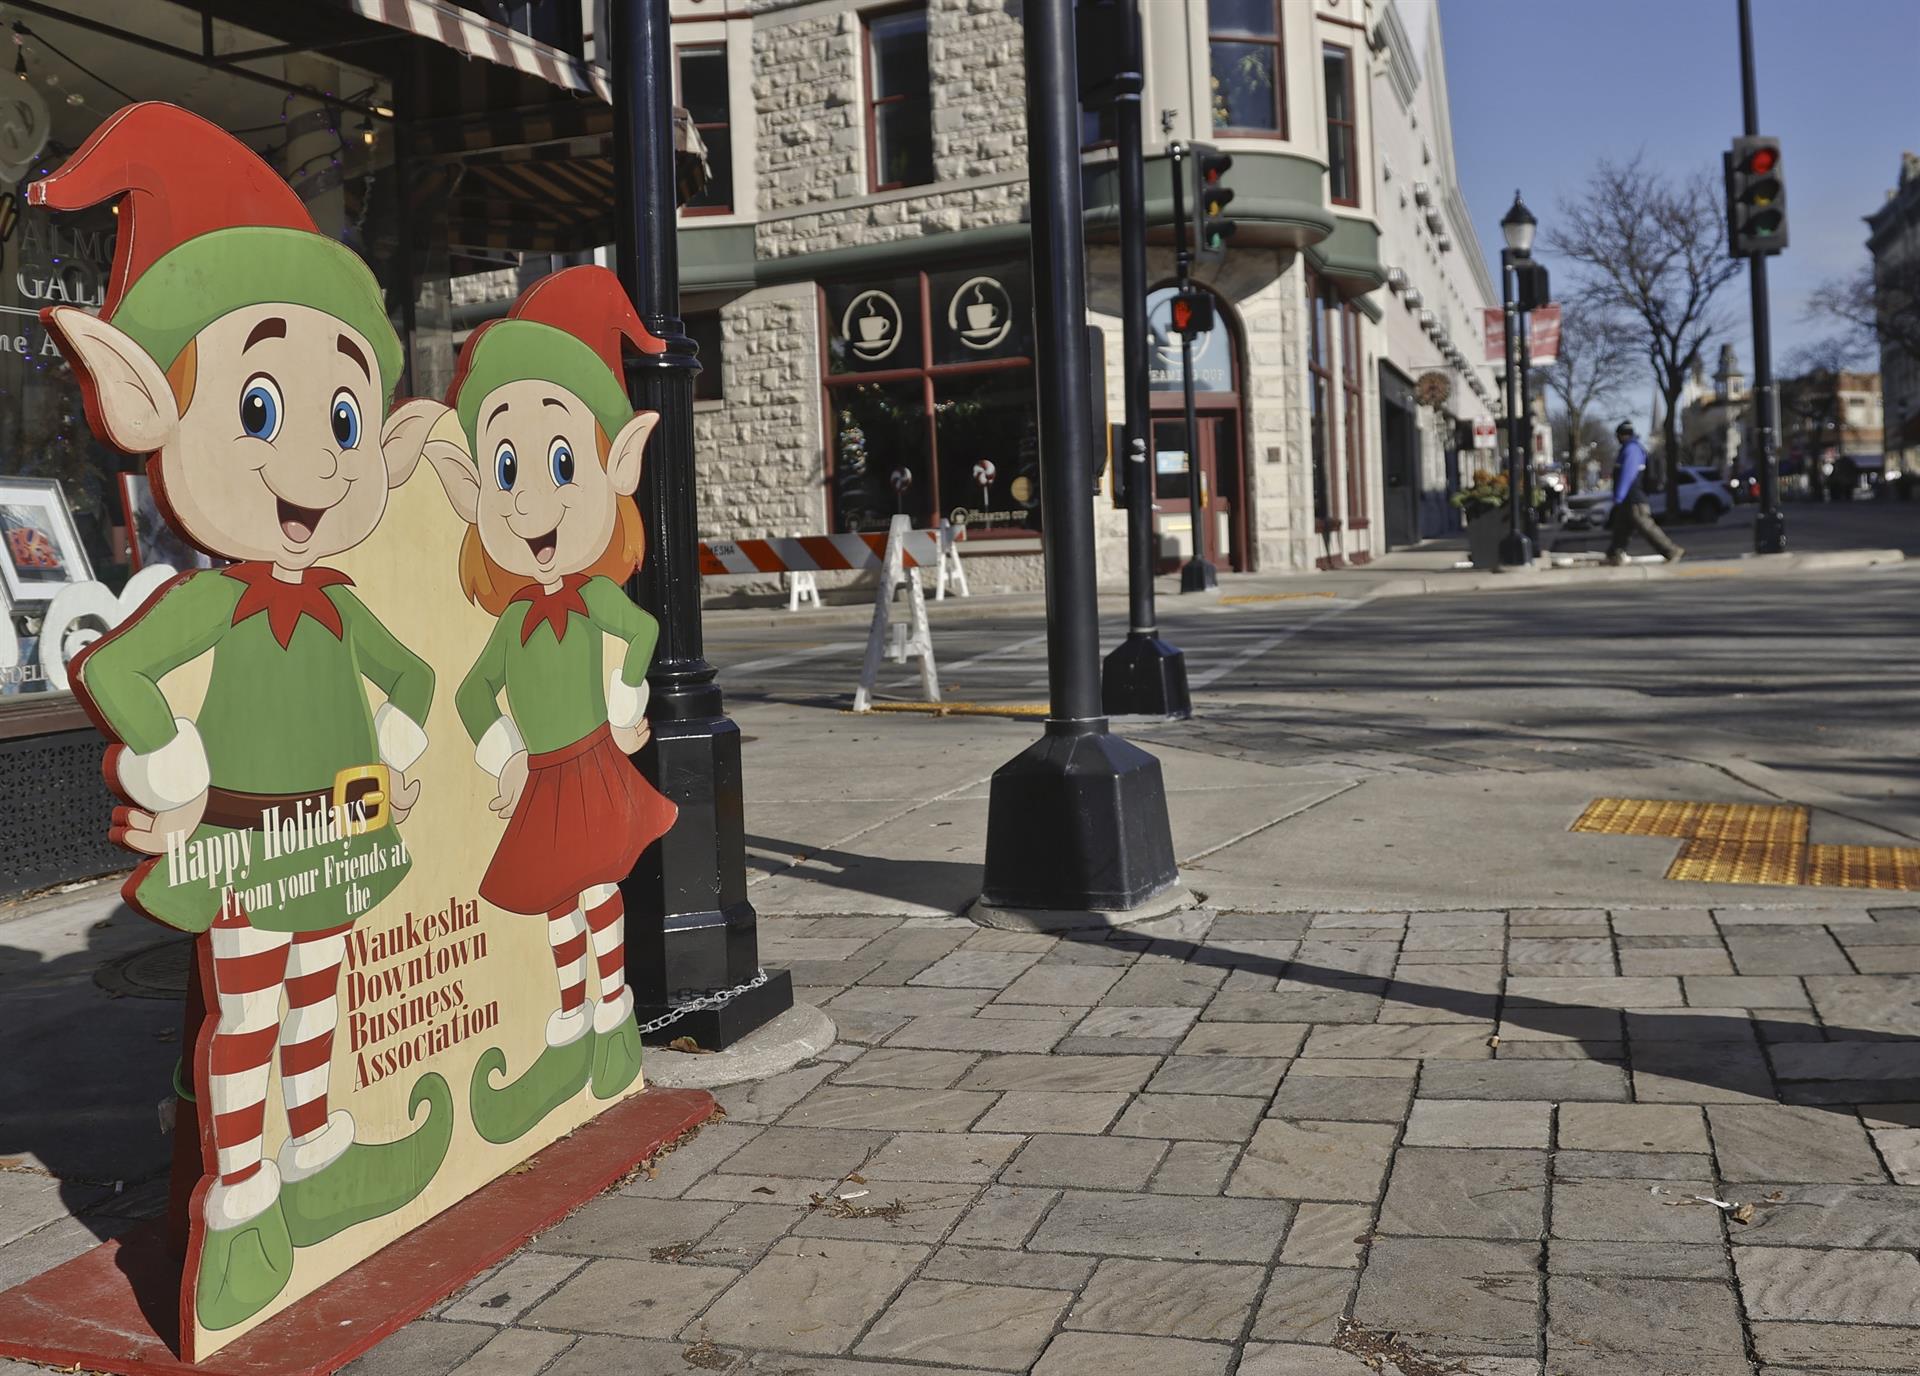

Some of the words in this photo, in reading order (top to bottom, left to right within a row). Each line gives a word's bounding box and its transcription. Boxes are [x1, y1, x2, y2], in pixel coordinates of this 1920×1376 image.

[166, 827, 254, 890] Happy
[261, 795, 367, 861] Holidays
[221, 884, 274, 921] From
[278, 868, 319, 911] your
[324, 843, 387, 889] Friends
[391, 840, 408, 867] at
[344, 882, 371, 916] the
[344, 896, 480, 971] Waukesha
[346, 932, 488, 1014] Downtown
[348, 979, 465, 1054] Business
[353, 1000, 500, 1093] Association
